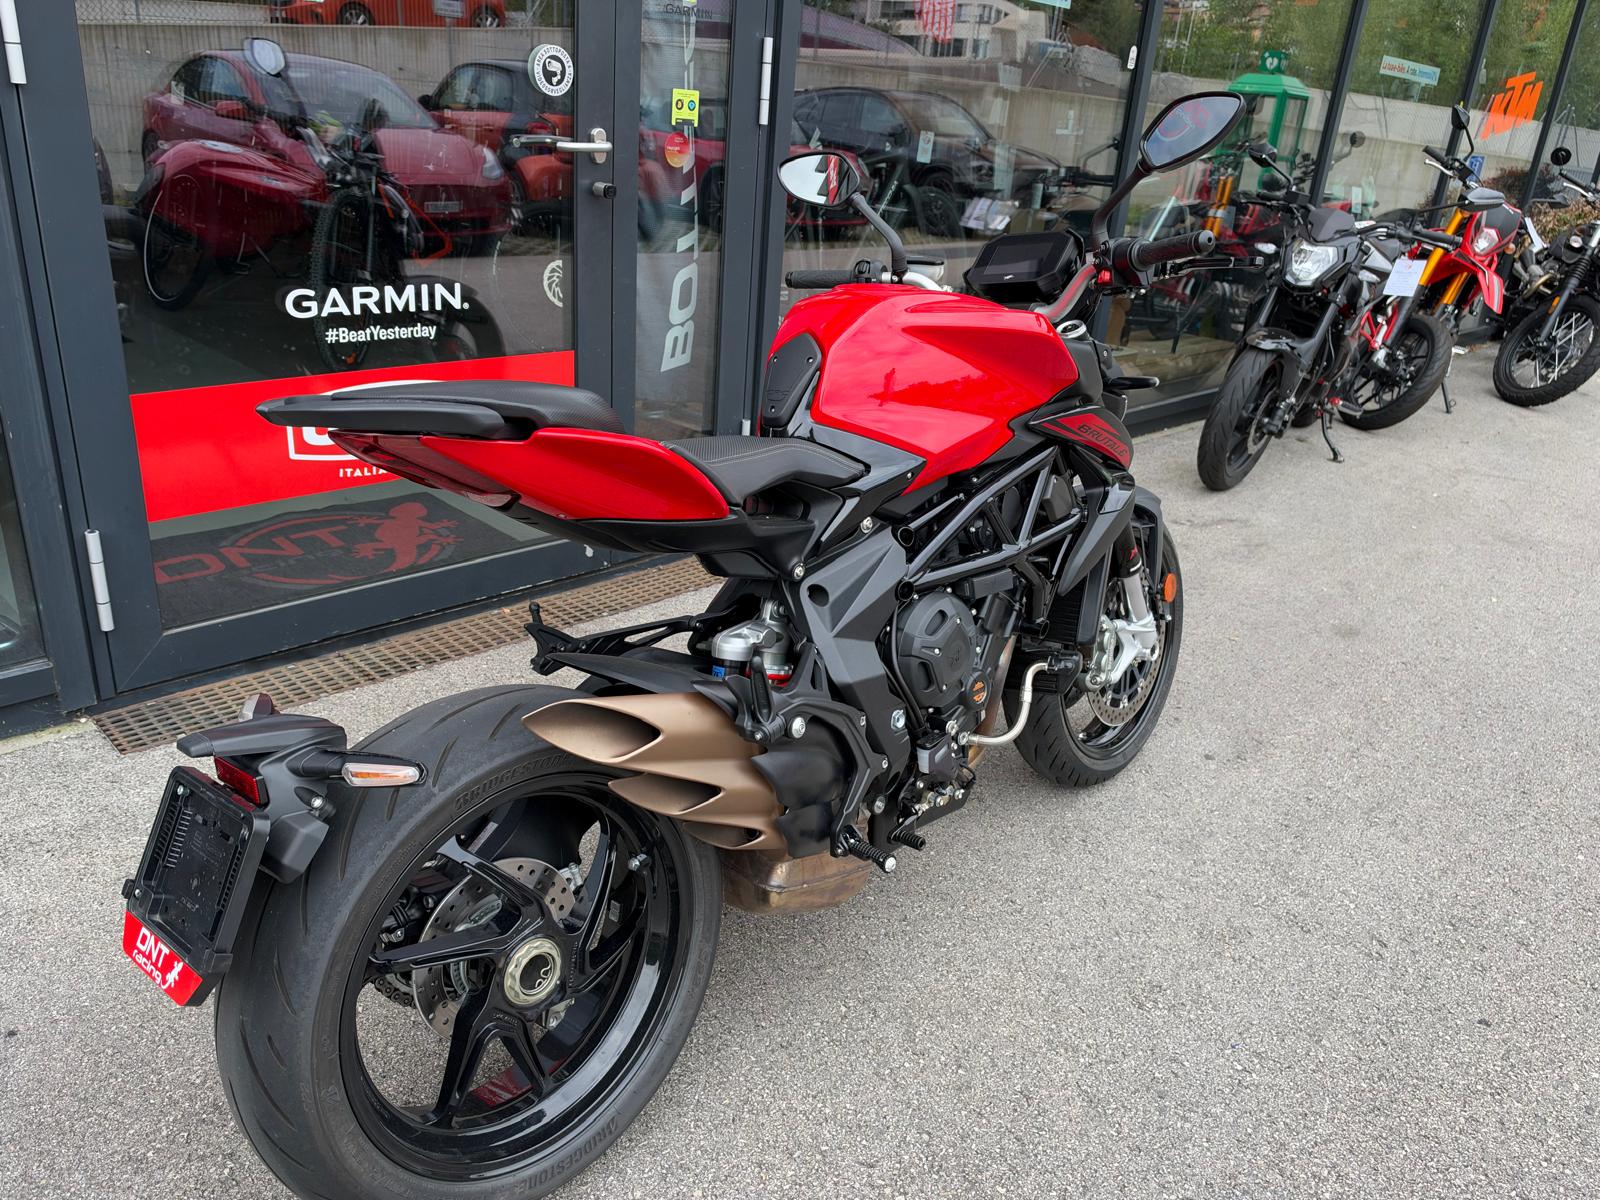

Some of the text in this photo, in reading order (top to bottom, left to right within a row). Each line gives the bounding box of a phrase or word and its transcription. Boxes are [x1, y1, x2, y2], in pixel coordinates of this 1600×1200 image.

[665, 3, 713, 20] GARMIN
[1480, 71, 1543, 141] KTM
[325, 323, 437, 344] #BeatYesterday
[1077, 424, 1127, 457] BRUTALE
[154, 526, 348, 584] DNT
[136, 927, 170, 968] DNT
[132, 949, 162, 985] racing
